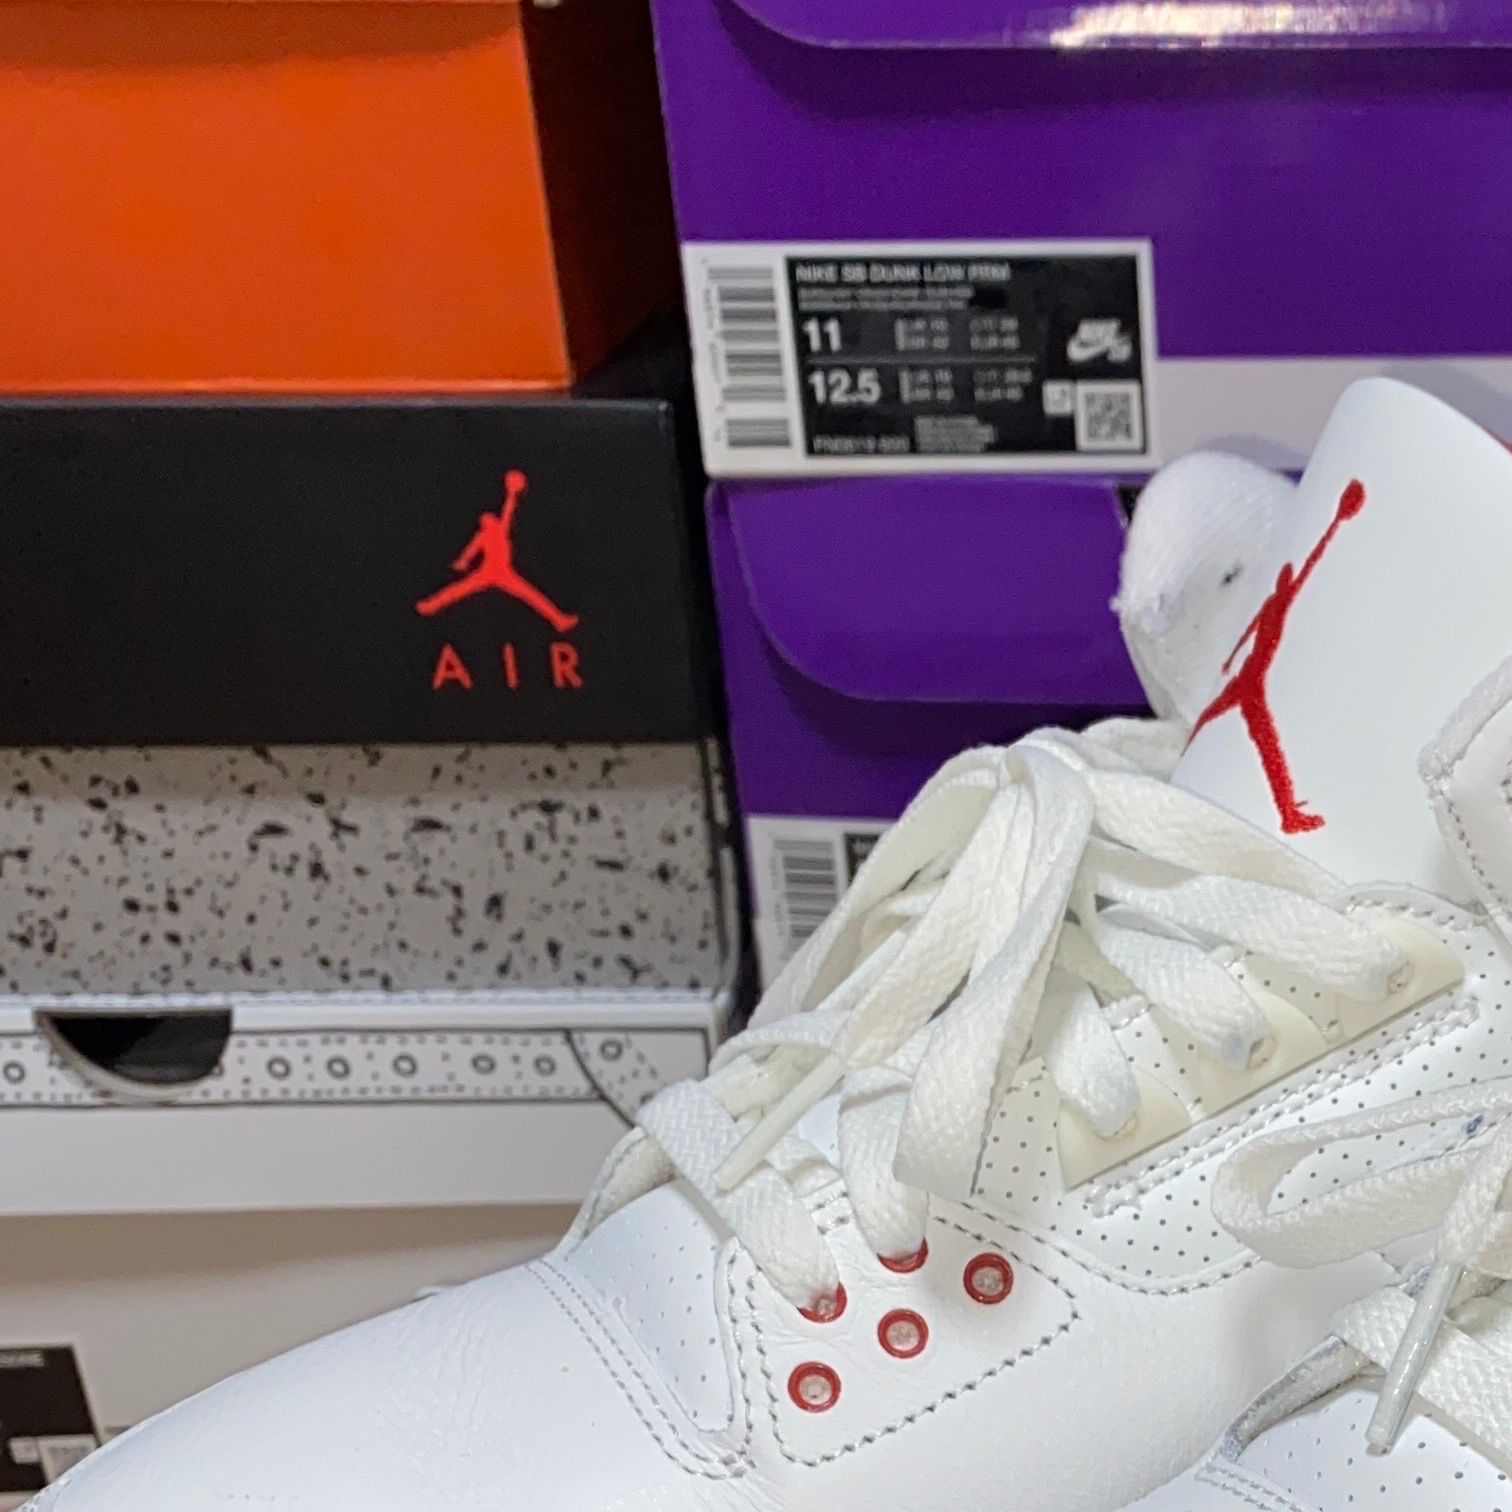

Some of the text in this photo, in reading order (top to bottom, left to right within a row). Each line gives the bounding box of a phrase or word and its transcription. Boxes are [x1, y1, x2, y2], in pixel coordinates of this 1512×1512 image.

[803, 317, 842, 353] 11
[808, 367, 882, 405] 12.5
[431, 641, 585, 690] AIR
